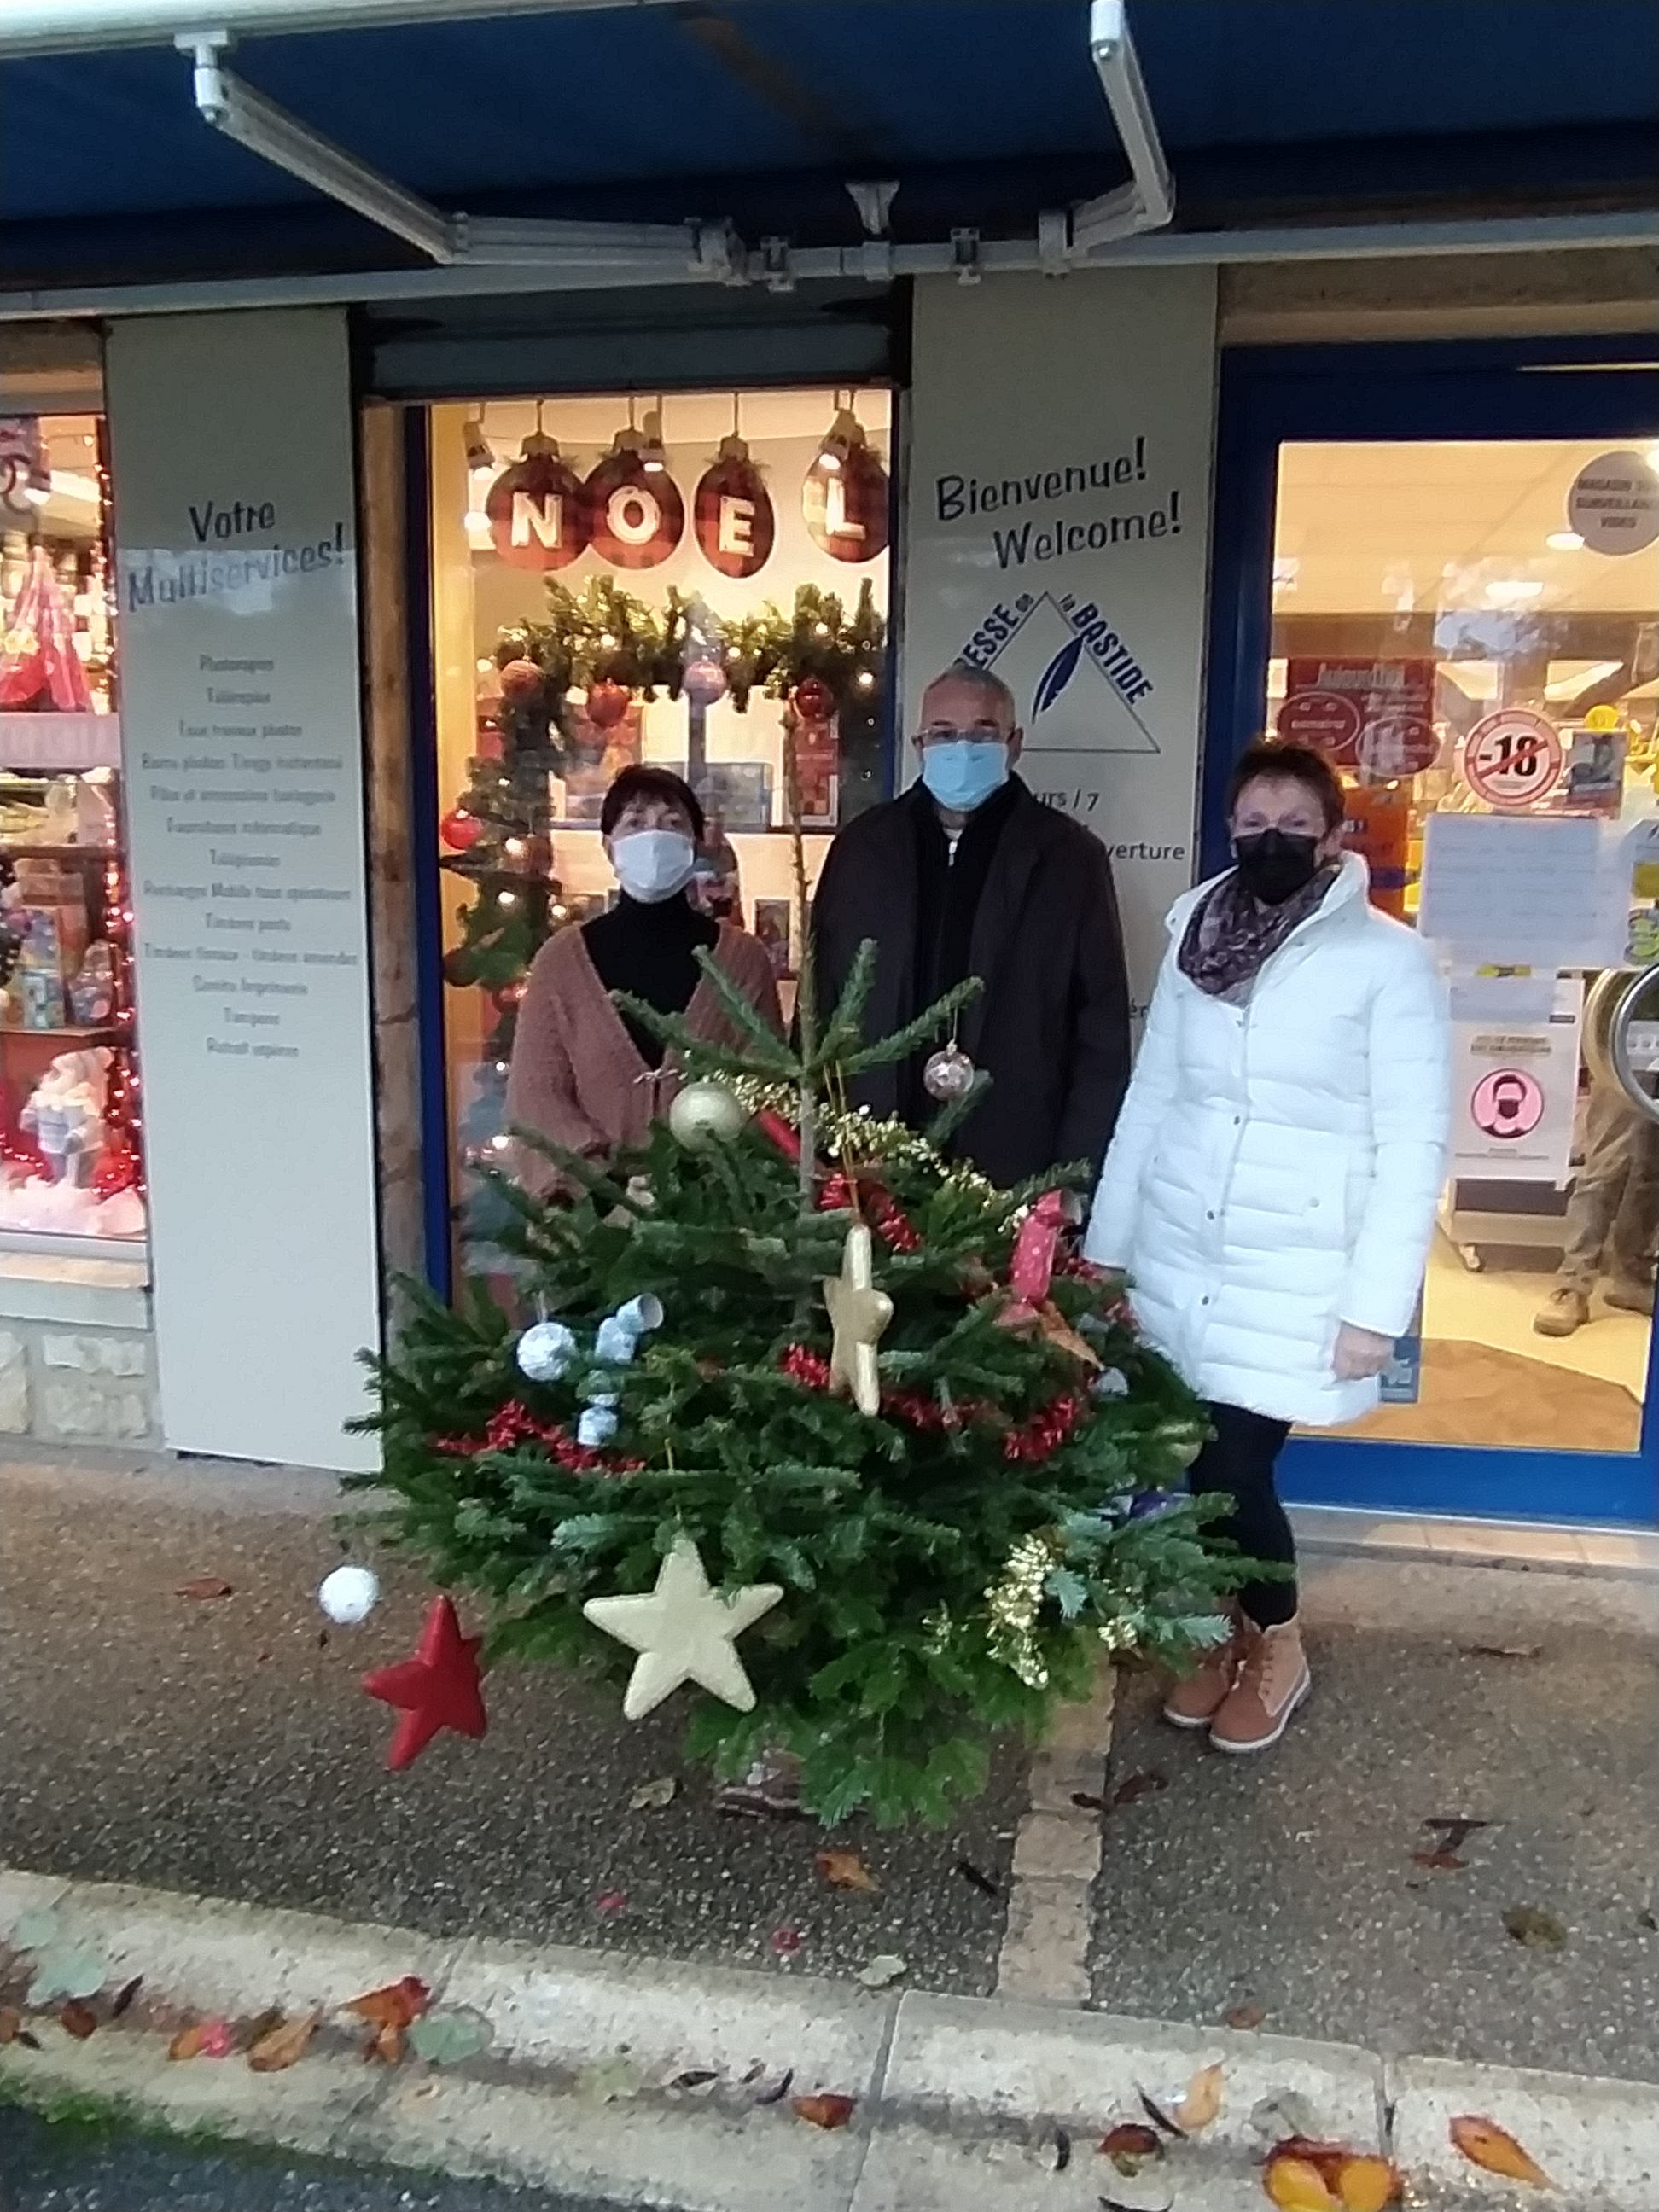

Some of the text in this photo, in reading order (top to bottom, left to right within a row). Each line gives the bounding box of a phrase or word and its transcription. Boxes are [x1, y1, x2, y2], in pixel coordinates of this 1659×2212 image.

[511, 477, 866, 557] NOEL
[936, 435, 1146, 521] Bienvenue!
[189, 501, 276, 543] Votre
[992, 490, 1181, 569] Welcome!
[953, 603, 1020, 670] ESSE
[1071, 602, 1154, 705] BASTIDE
[1479, 734, 1539, 777] -18
[1033, 792, 1067, 807] urs
[1087, 792, 1099, 812] 7
